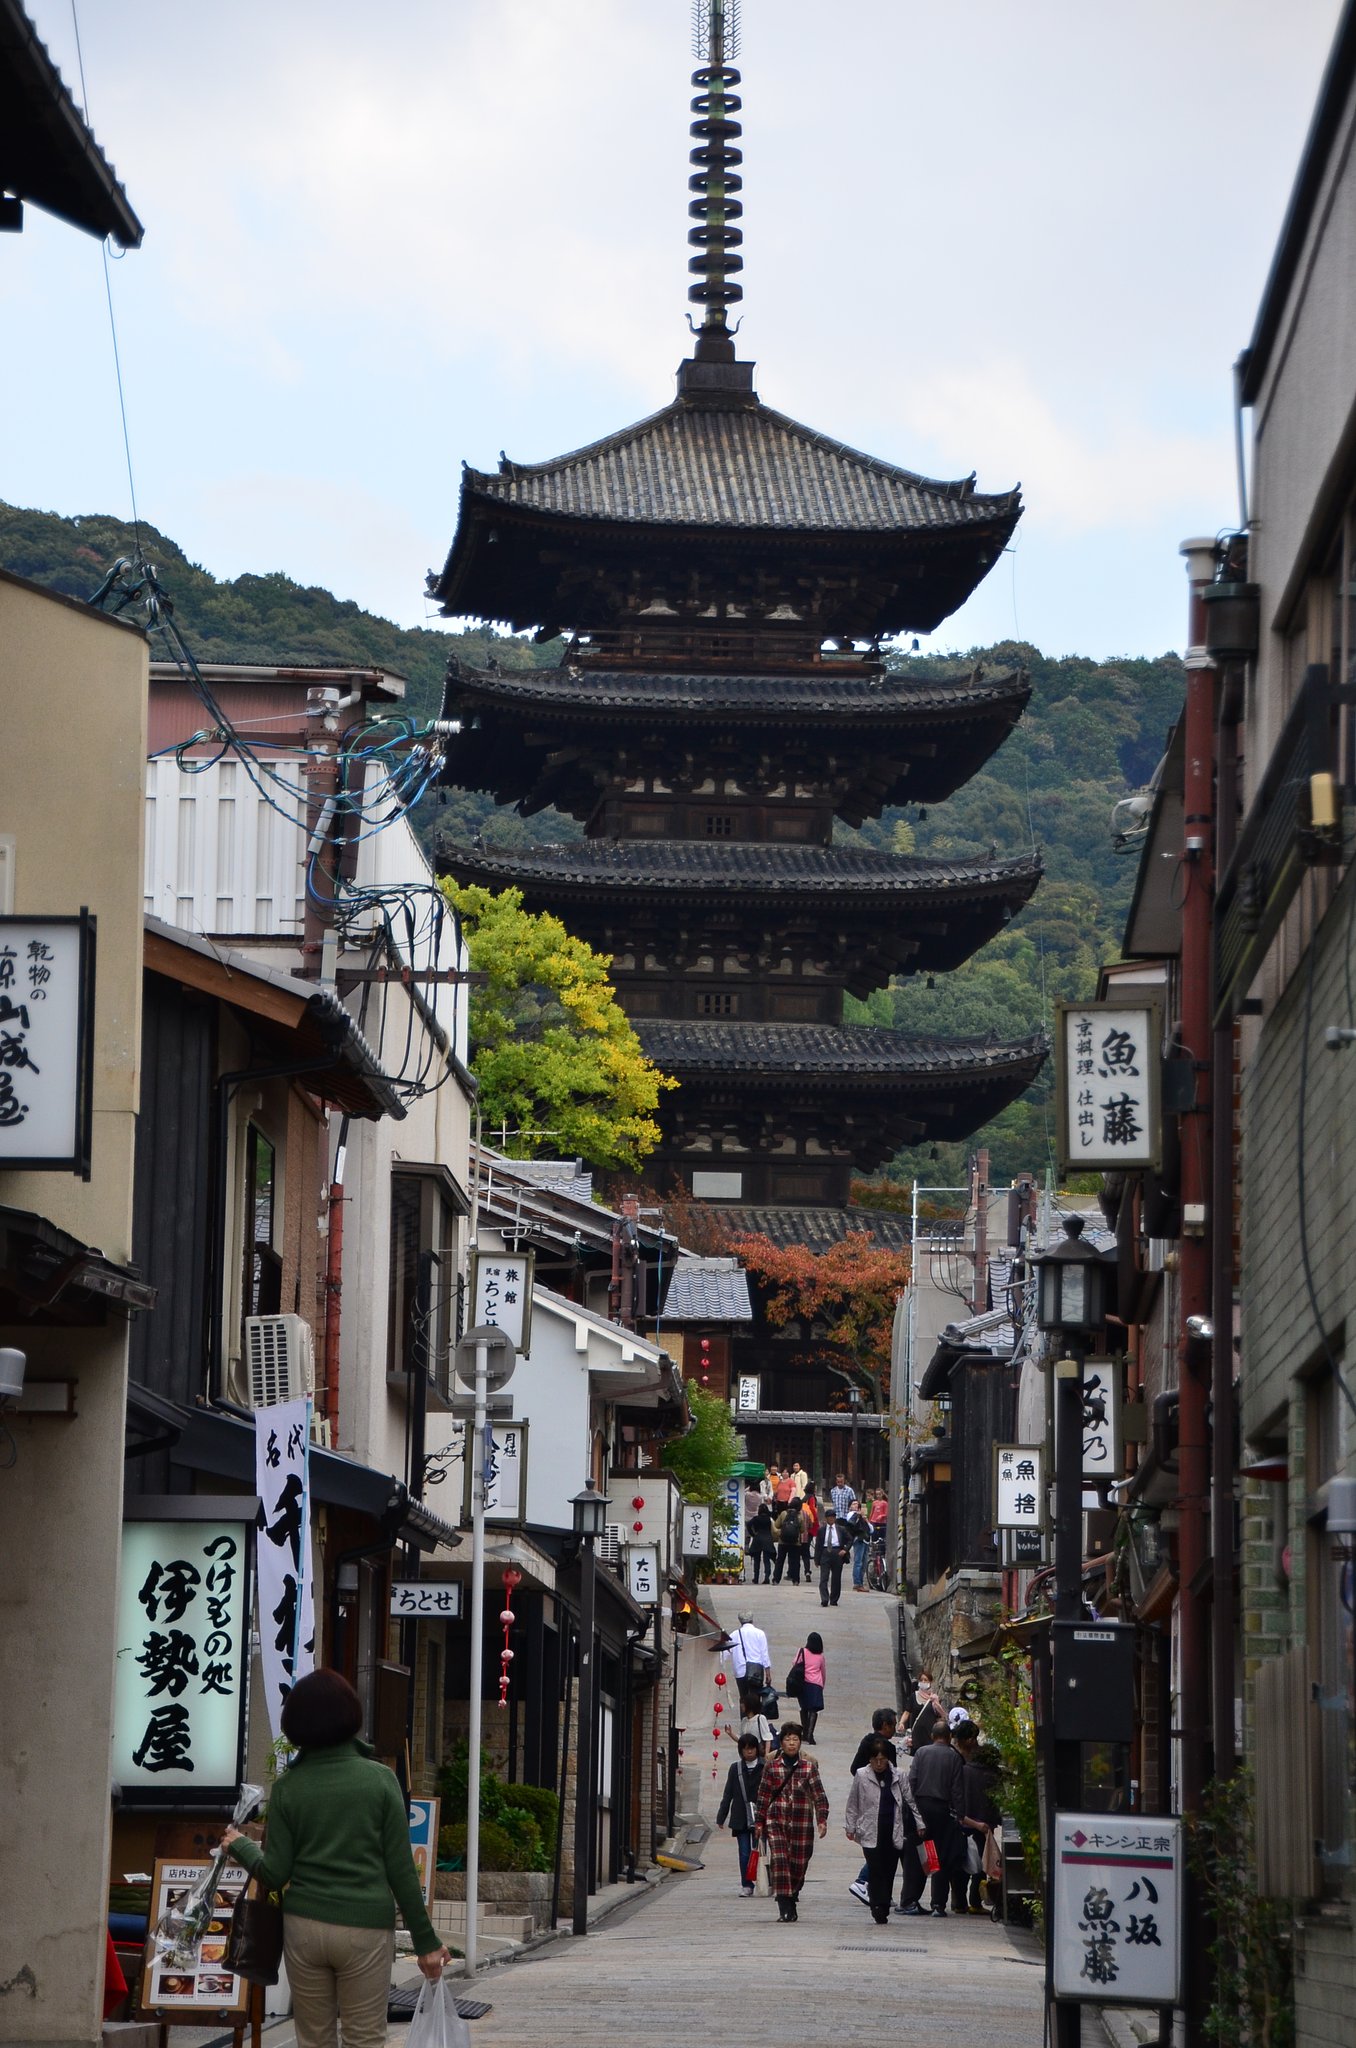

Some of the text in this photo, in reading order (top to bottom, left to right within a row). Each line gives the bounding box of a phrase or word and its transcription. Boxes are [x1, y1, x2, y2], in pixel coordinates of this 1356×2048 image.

[1098, 1028, 1143, 1146] 魚藤
[505, 1269, 520, 1304] 旅館
[1001, 1452, 1013, 1481] 鮮魚
[1014, 1460, 1036, 1514] 魚捨
[690, 1511, 702, 1549] やまだ
[636, 1558, 650, 1592] 大西
[199, 1535, 237, 1695] つけもの処
[399, 1589, 453, 1611] ちとせ
[132, 1560, 201, 1772] 伊勢屋
[1088, 1833, 1170, 1852] キンシ正宗
[168, 1868, 243, 1880] 店内おがり
[1124, 1876, 1162, 1946] 八坂
[1078, 1885, 1120, 1985] 魚藤
